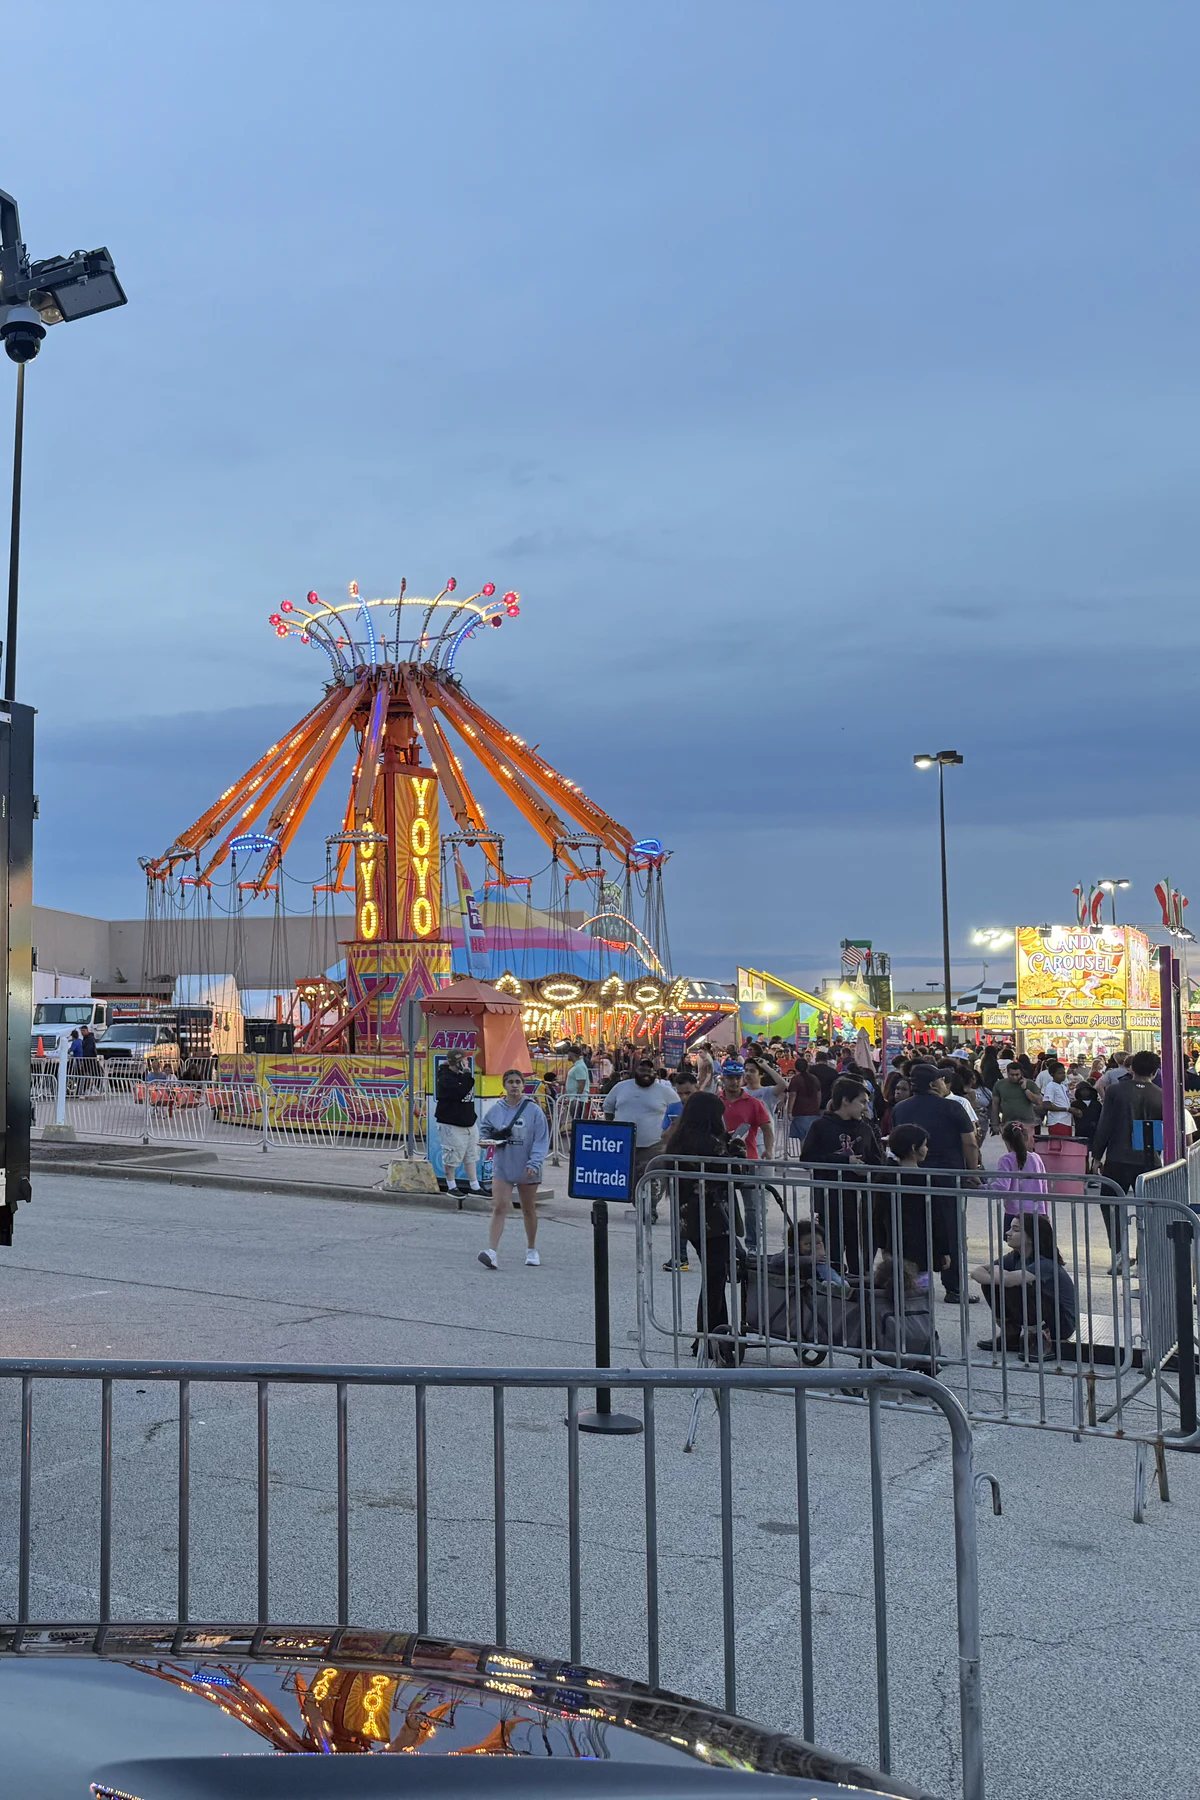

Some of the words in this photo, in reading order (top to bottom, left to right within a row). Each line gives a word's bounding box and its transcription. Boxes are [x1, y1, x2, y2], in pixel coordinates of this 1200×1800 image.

[411, 777, 432, 936] YOYO
[360, 820, 378, 940] OYO
[1043, 933, 1101, 954] CANDY
[1028, 951, 1118, 974] CAROUSEL
[986, 1014, 1009, 1026] DRINKS
[1019, 1013, 1053, 1026] CARAMEL
[1055, 1015, 1062, 1025] &
[1063, 1013, 1089, 1026] CANDY
[1090, 1014, 1121, 1027] APPLES
[429, 1030, 477, 1050] ATM
[582, 1134, 623, 1153] Enter
[575, 1166, 626, 1186] Entrada
